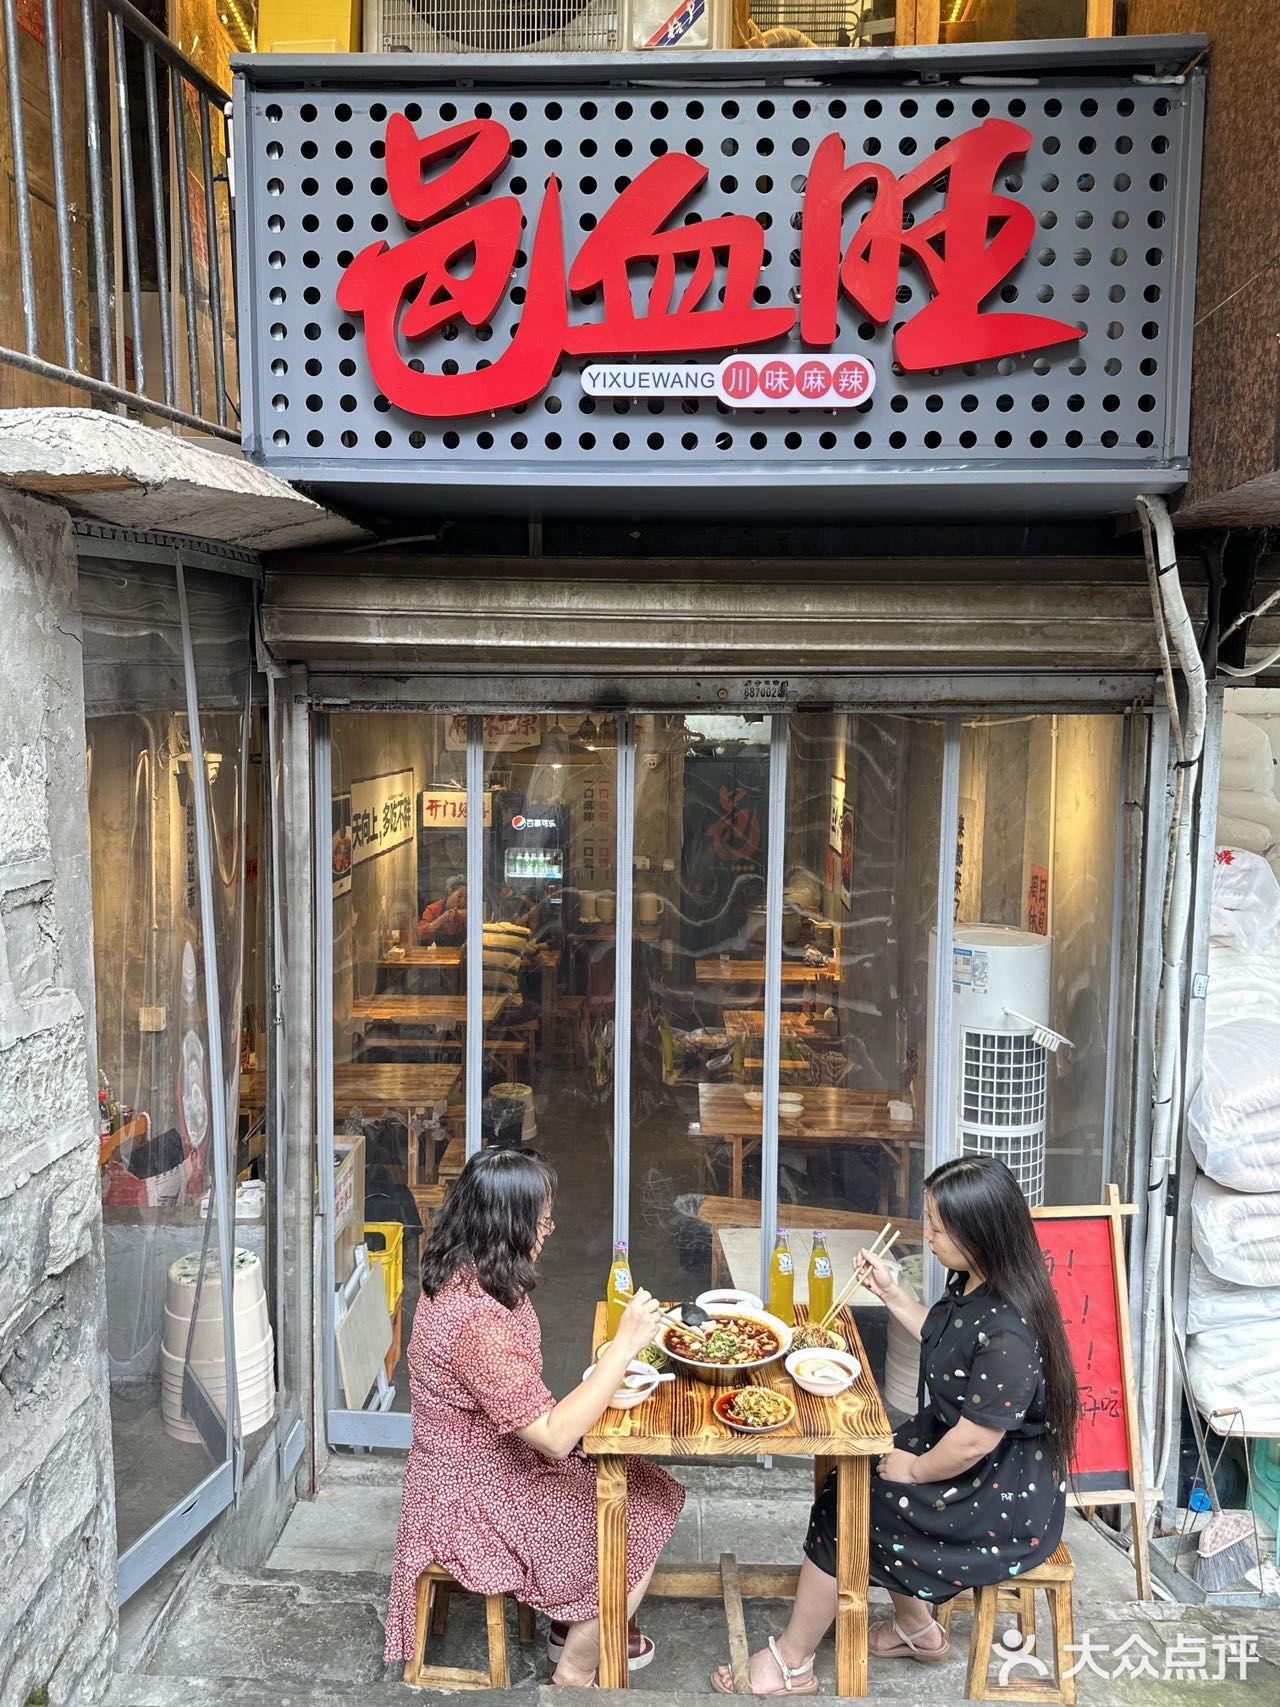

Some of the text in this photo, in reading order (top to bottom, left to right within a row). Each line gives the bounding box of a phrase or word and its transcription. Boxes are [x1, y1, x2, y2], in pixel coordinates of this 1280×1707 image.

[588, 372, 715, 389] YIXUEWANG
[727, 365, 866, 395] 川味麻辣
[425, 799, 490, 821] 开门见
